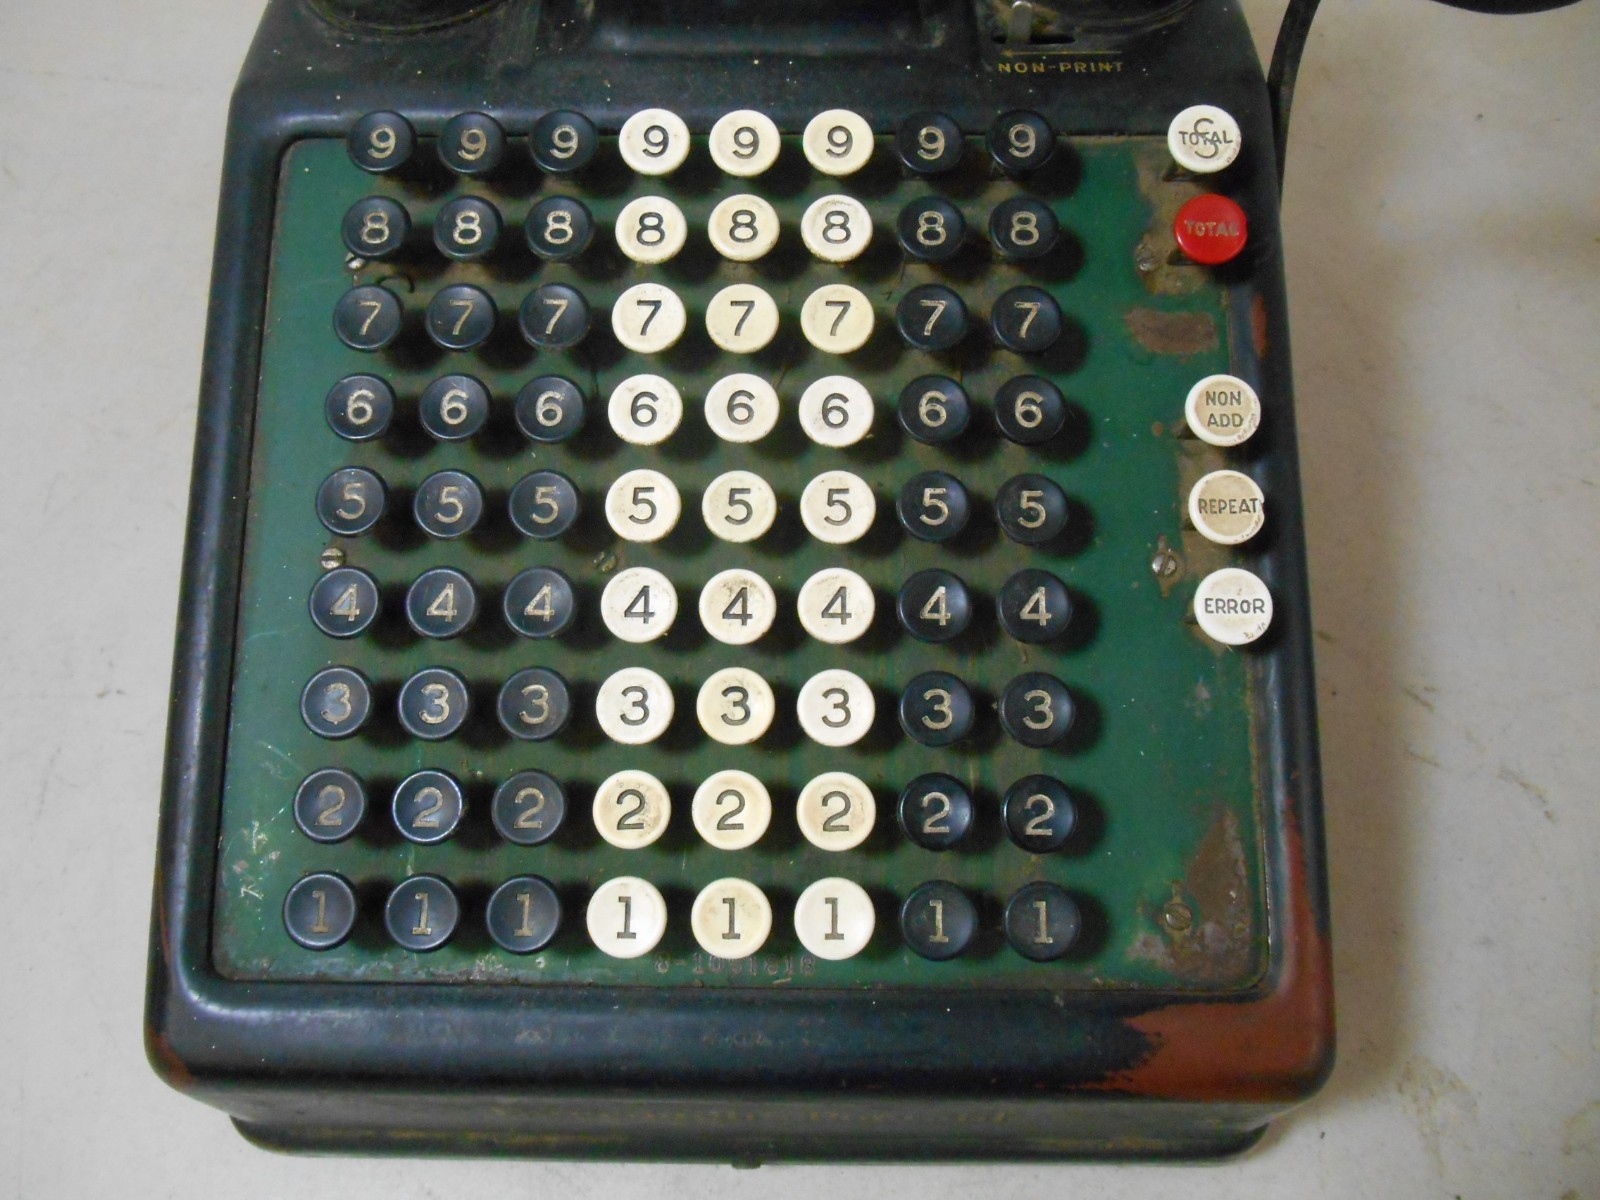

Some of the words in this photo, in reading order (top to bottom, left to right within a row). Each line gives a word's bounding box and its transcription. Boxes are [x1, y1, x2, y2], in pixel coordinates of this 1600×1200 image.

[998, 61, 1123, 73] NON-PRINT
[368, 128, 395, 158] 9
[458, 129, 486, 160] 9
[550, 125, 578, 158] 9
[642, 125, 669, 157] 9
[732, 127, 759, 159] 9
[826, 126, 853, 157] 9
[918, 126, 945, 160] 9
[1009, 124, 1035, 157] 9
[1179, 130, 1233, 145] TOTAL
[362, 212, 389, 243] 8
[453, 211, 481, 244] 8
[544, 211, 573, 244] 8
[636, 212, 665, 246] 8
[729, 210, 758, 243] 8
[822, 210, 851, 244] 8
[917, 211, 946, 245] 8
[1011, 211, 1039, 245] 8
[1184, 220, 1239, 237] TOTAL
[357, 301, 381, 335] 7
[450, 299, 474, 335] 7
[543, 299, 568, 334] 7
[637, 300, 662, 335] 7
[730, 300, 755, 336] 7
[826, 301, 851, 336] 7
[921, 300, 947, 335] 7
[1015, 302, 1040, 338] 7
[347, 389, 374, 424] 6
[441, 390, 467, 424] 6
[536, 391, 562, 426] 6
[631, 391, 659, 427] 6
[727, 390, 755, 425] 6
[822, 393, 849, 429] 6
[919, 391, 946, 427] 6
[1015, 392, 1043, 428] 6
[1206, 390, 1242, 406] NON
[1208, 413, 1243, 428] ADD
[336, 483, 365, 519] 5
[434, 487, 463, 523] 5
[532, 486, 560, 523] 5
[628, 487, 656, 524] 5
[725, 488, 753, 525] 5
[824, 488, 852, 526] 5
[920, 488, 948, 525] 5
[1018, 491, 1046, 528] 5
[1199, 498, 1257, 514] REPEAT
[330, 584, 360, 621] 4
[427, 584, 457, 622] 4
[524, 586, 554, 621] 4
[624, 585, 655, 624] 4
[722, 587, 752, 626] 4
[821, 586, 852, 625] 4
[920, 586, 951, 625] 4
[1020, 587, 1051, 625] 4
[1205, 598, 1265, 614] ERROR
[321, 684, 351, 721] 3
[422, 684, 449, 723] 3
[520, 685, 548, 723] 3
[620, 686, 649, 726] 3
[721, 686, 750, 726] 3
[822, 688, 851, 728] 3
[922, 689, 952, 729] 3
[1023, 690, 1053, 729] 3
[314, 785, 343, 825] 2
[412, 787, 440, 827] 2
[515, 788, 544, 828] 2
[617, 789, 646, 830] 2
[716, 789, 745, 830] 2
[822, 791, 851, 832] 2
[923, 792, 950, 833] 2
[1025, 794, 1054, 835] 2
[311, 891, 328, 932] 1
[412, 893, 432, 934] 1
[514, 894, 532, 936] 1
[617, 896, 636, 938] 1
[722, 898, 740, 940] 1
[825, 897, 844, 940] 1
[930, 900, 948, 942] 1
[1033, 901, 1053, 943] 1
